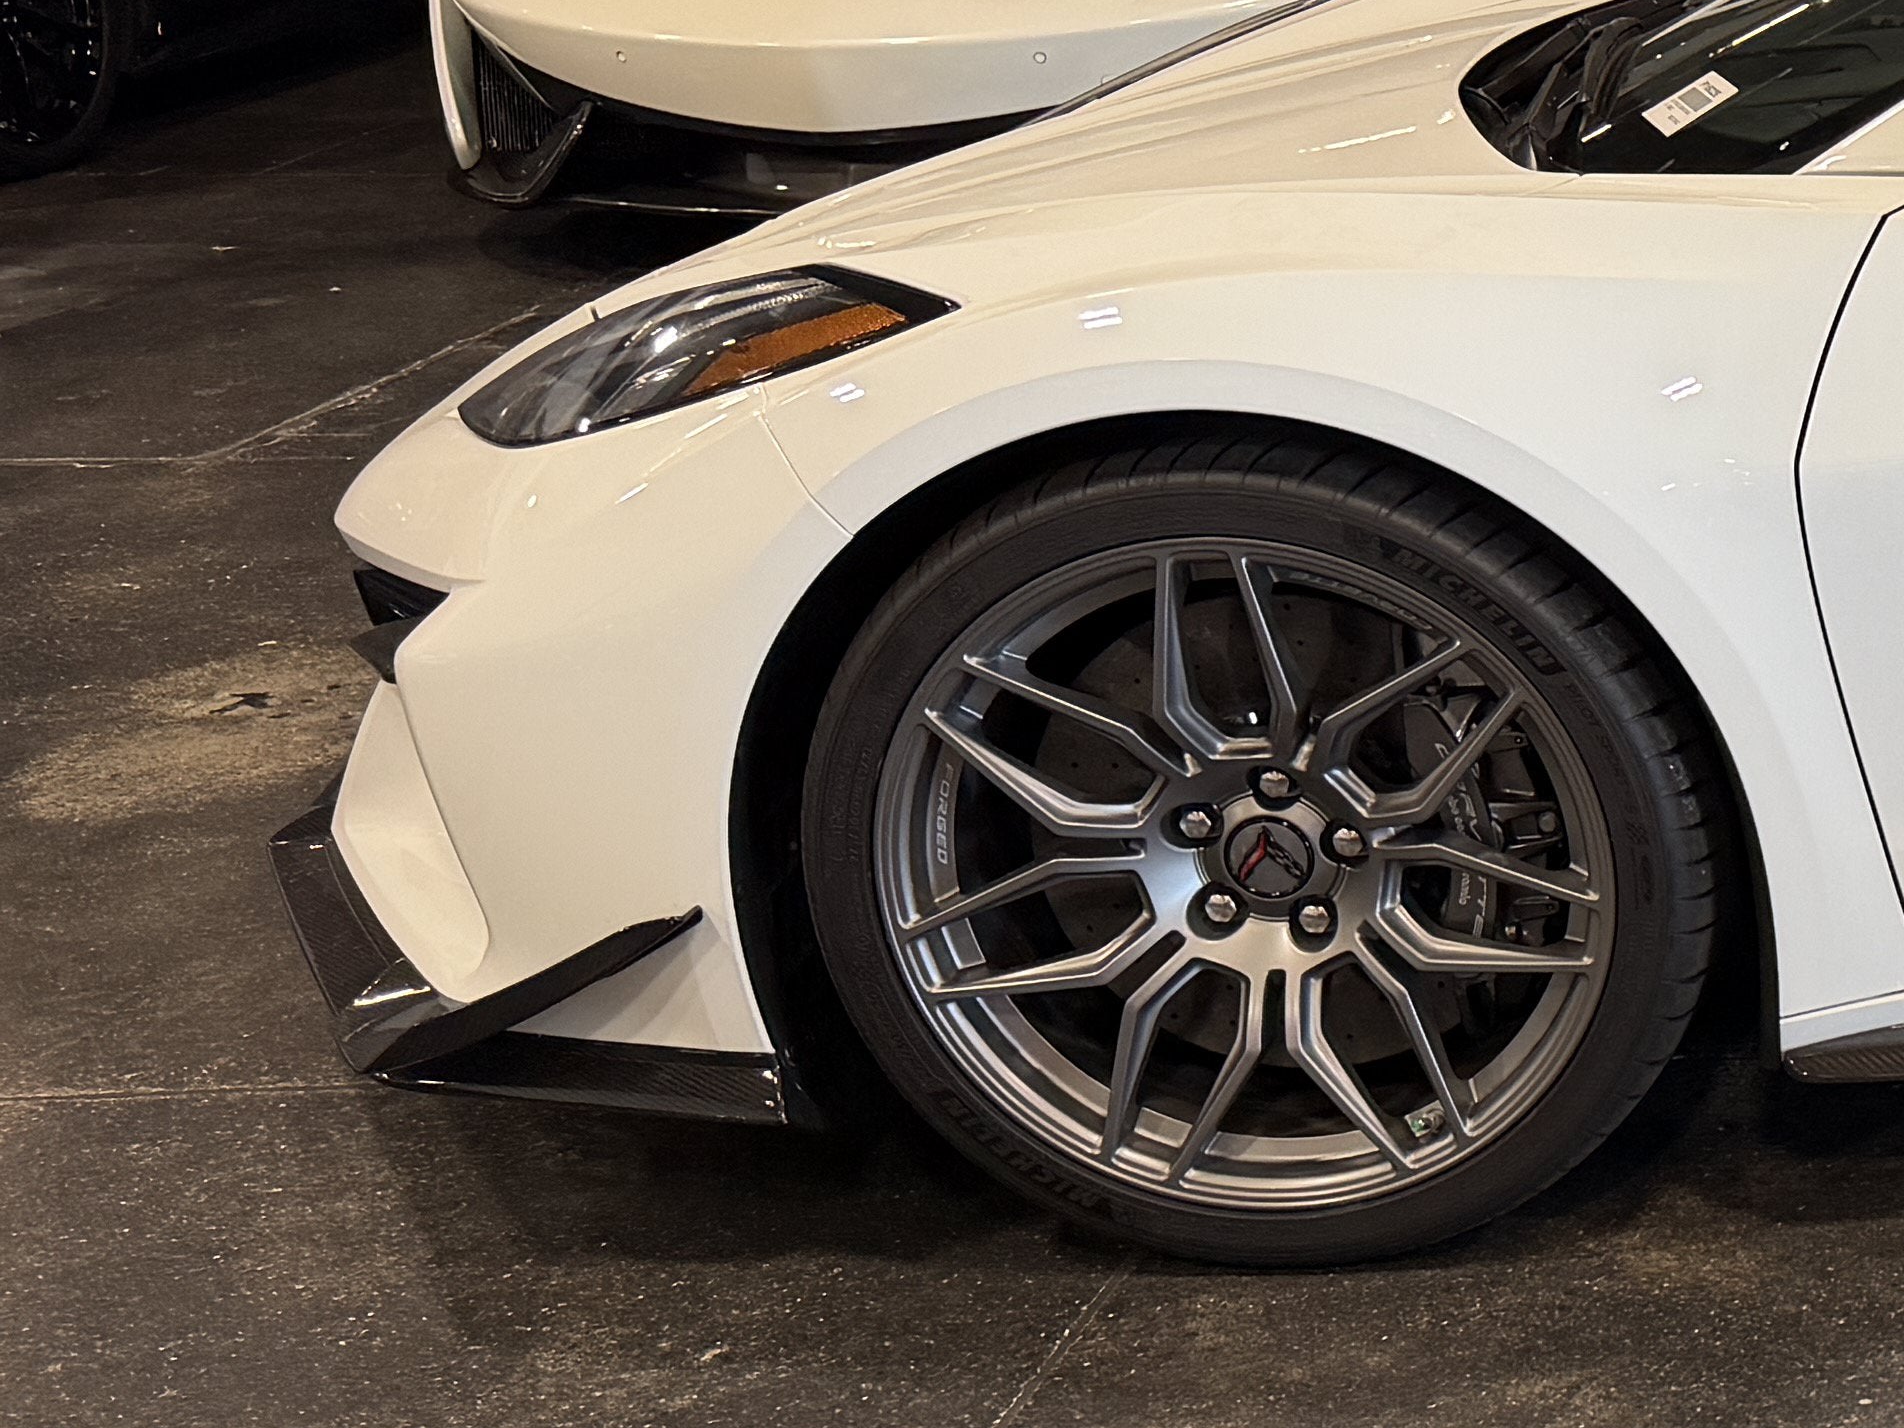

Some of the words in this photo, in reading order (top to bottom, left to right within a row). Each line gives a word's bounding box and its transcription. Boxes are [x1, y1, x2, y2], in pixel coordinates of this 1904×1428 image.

[1391, 548, 1558, 671] MICHELIN
[937, 761, 955, 865] FORGED
[941, 1097, 1103, 1207] MICHELIN
